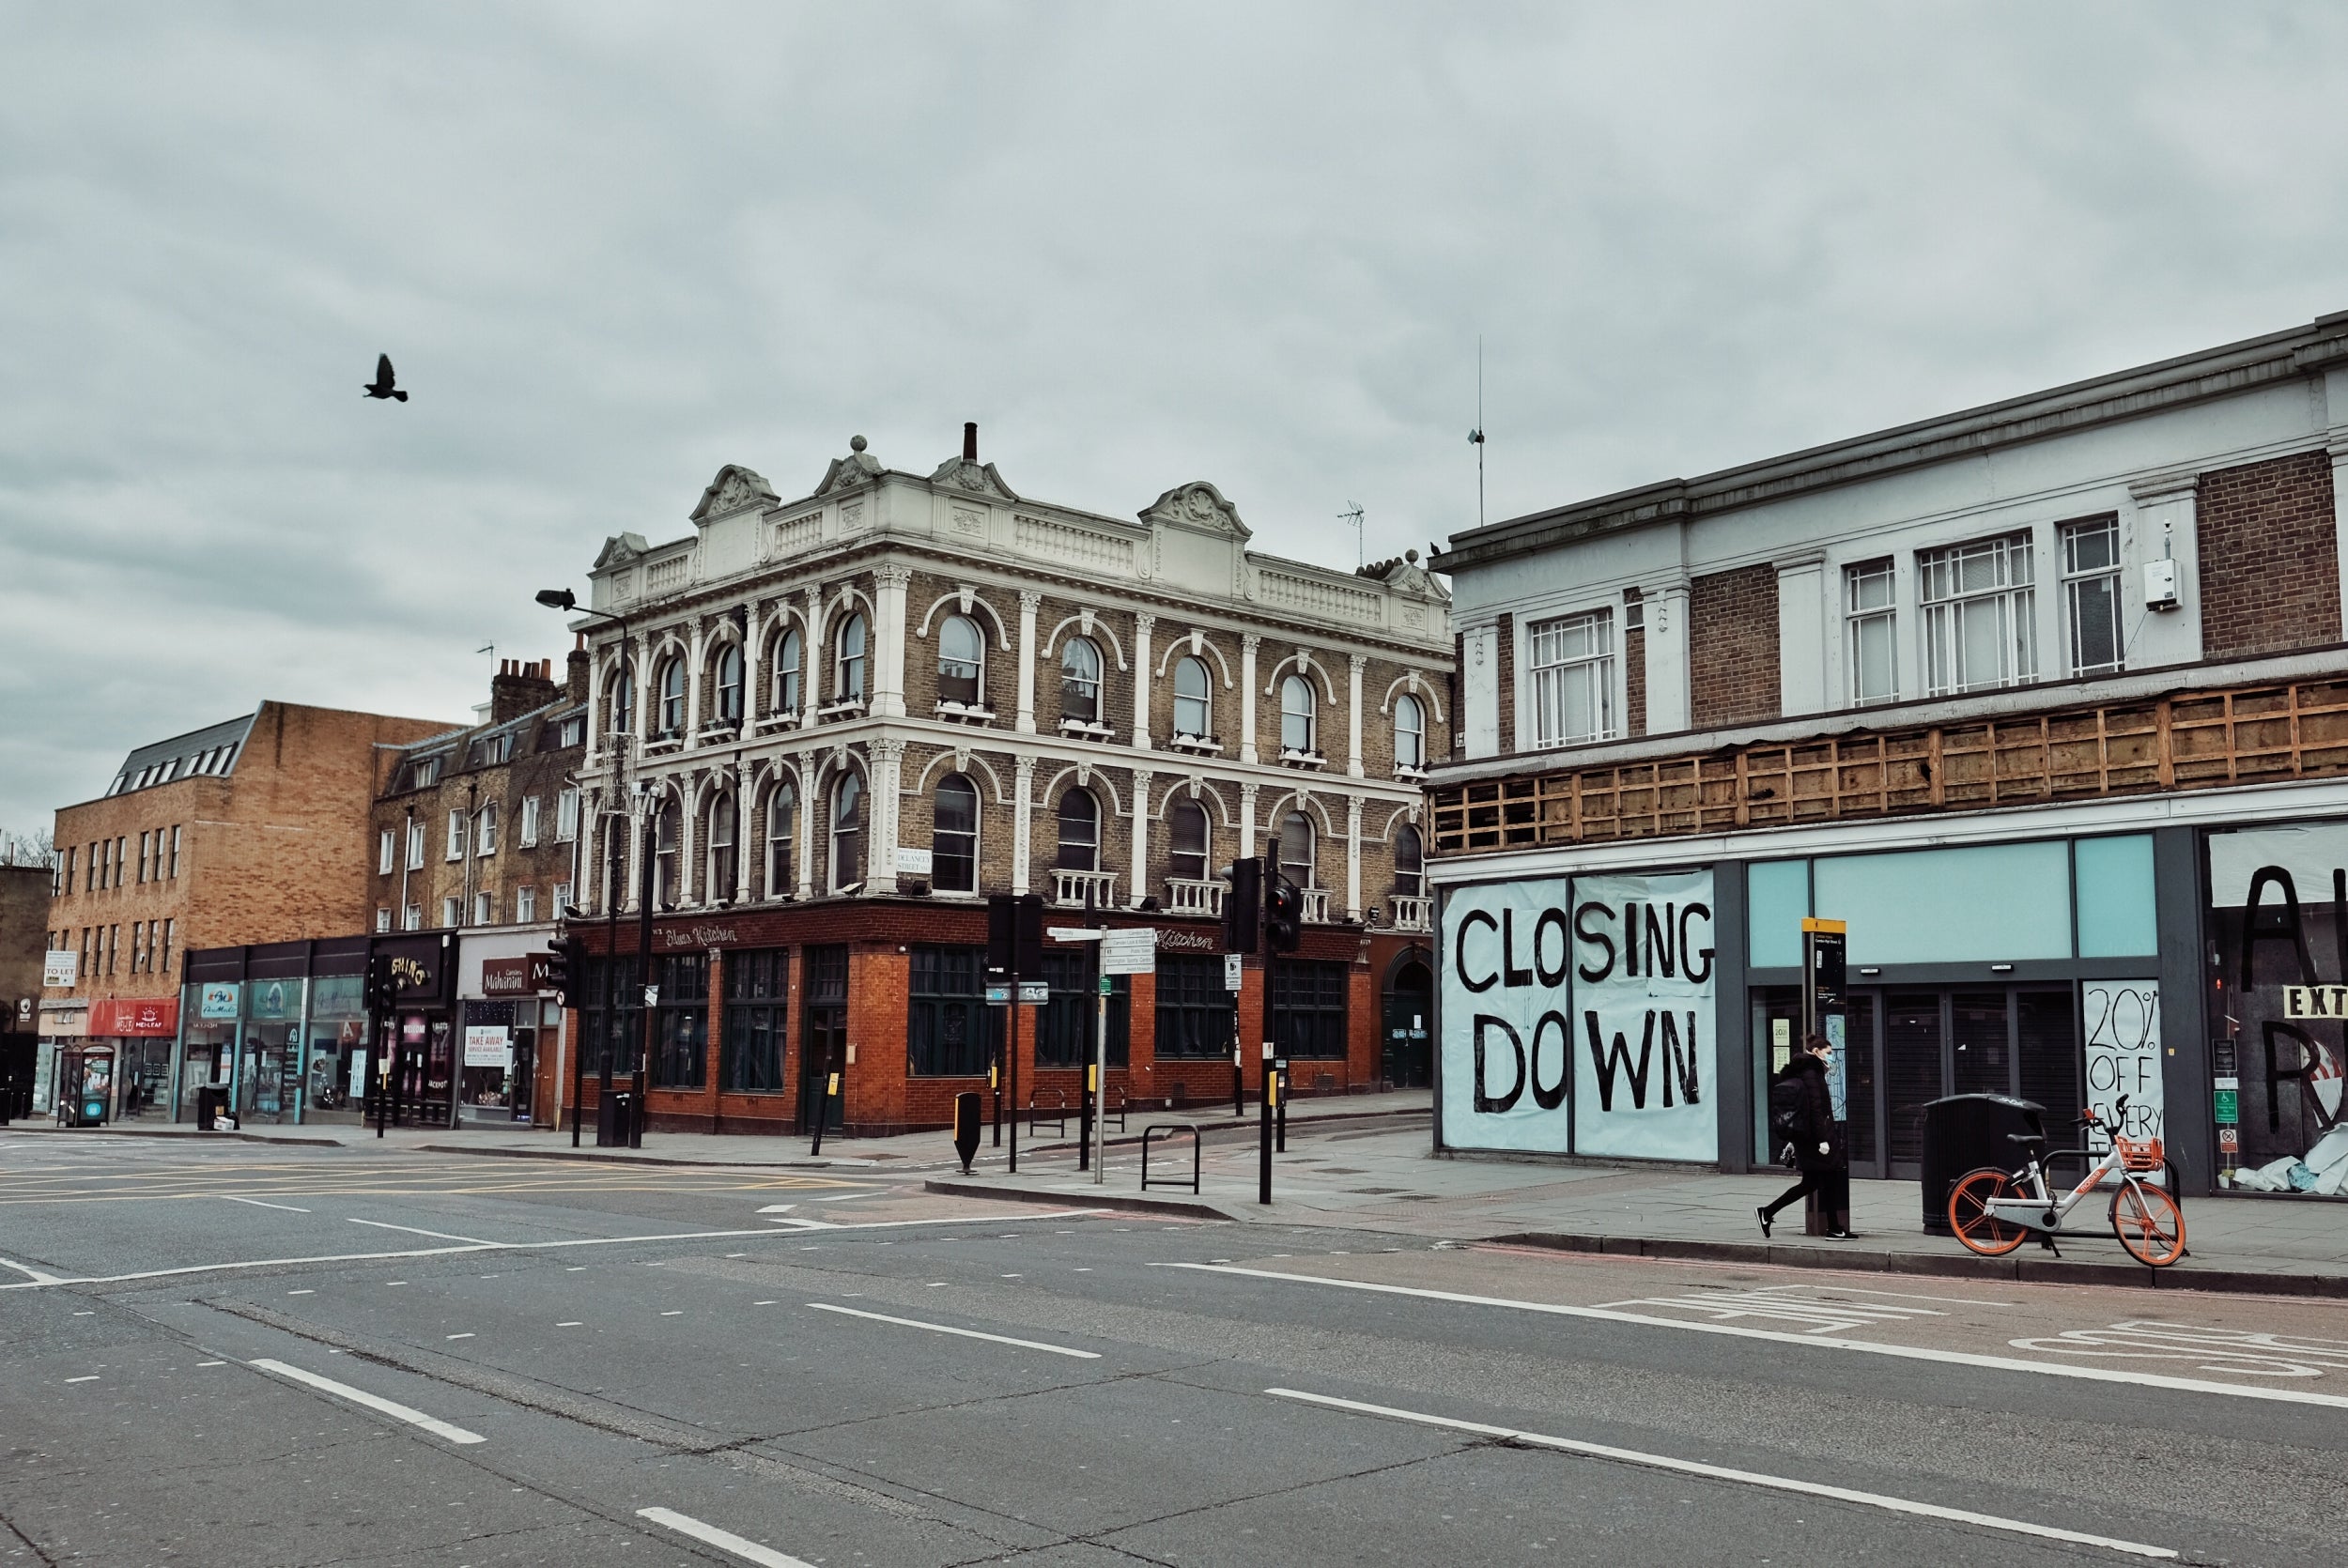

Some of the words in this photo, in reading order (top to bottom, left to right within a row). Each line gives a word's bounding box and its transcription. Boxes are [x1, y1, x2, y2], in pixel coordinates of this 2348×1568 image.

[898, 854, 931, 863] DELANCEY
[666, 930, 693, 947] Blues
[692, 926, 738, 946] Kitchen
[1155, 929, 1214, 950] Kitchen
[1457, 900, 1715, 992] CLOSING
[485, 971, 522, 990] Maharani
[2088, 989, 2158, 1051] 20%
[470, 1037, 484, 1045] TAKE
[485, 1037, 503, 1045] AWAY
[1474, 1010, 1700, 1113] DOWN
[2090, 1055, 2153, 1093] OFF
